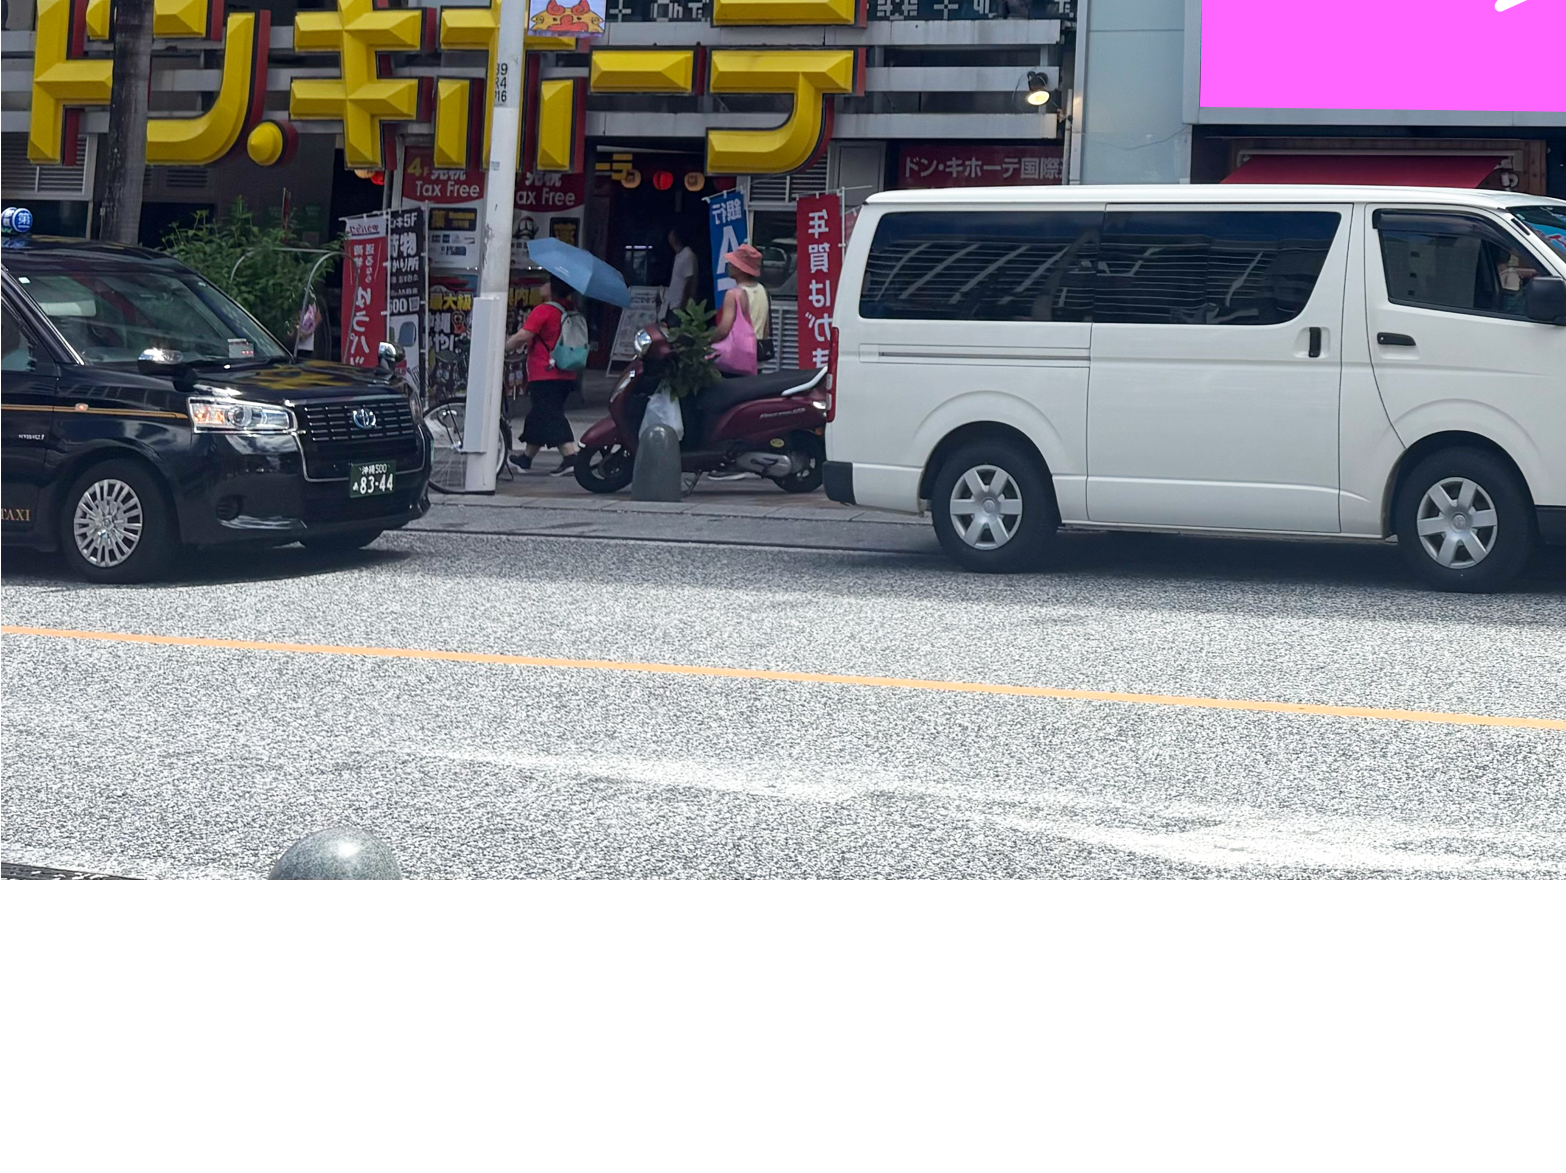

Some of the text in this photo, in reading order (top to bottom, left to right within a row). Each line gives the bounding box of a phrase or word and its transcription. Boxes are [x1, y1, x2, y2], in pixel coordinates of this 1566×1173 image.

[905, 156, 1063, 180] ドン・キホーテ国際
[415, 180, 481, 198] Tax Free
[515, 187, 576, 206] ax Free
[375, 463, 388, 475] 500
[1, 508, 31, 522] TAXI
